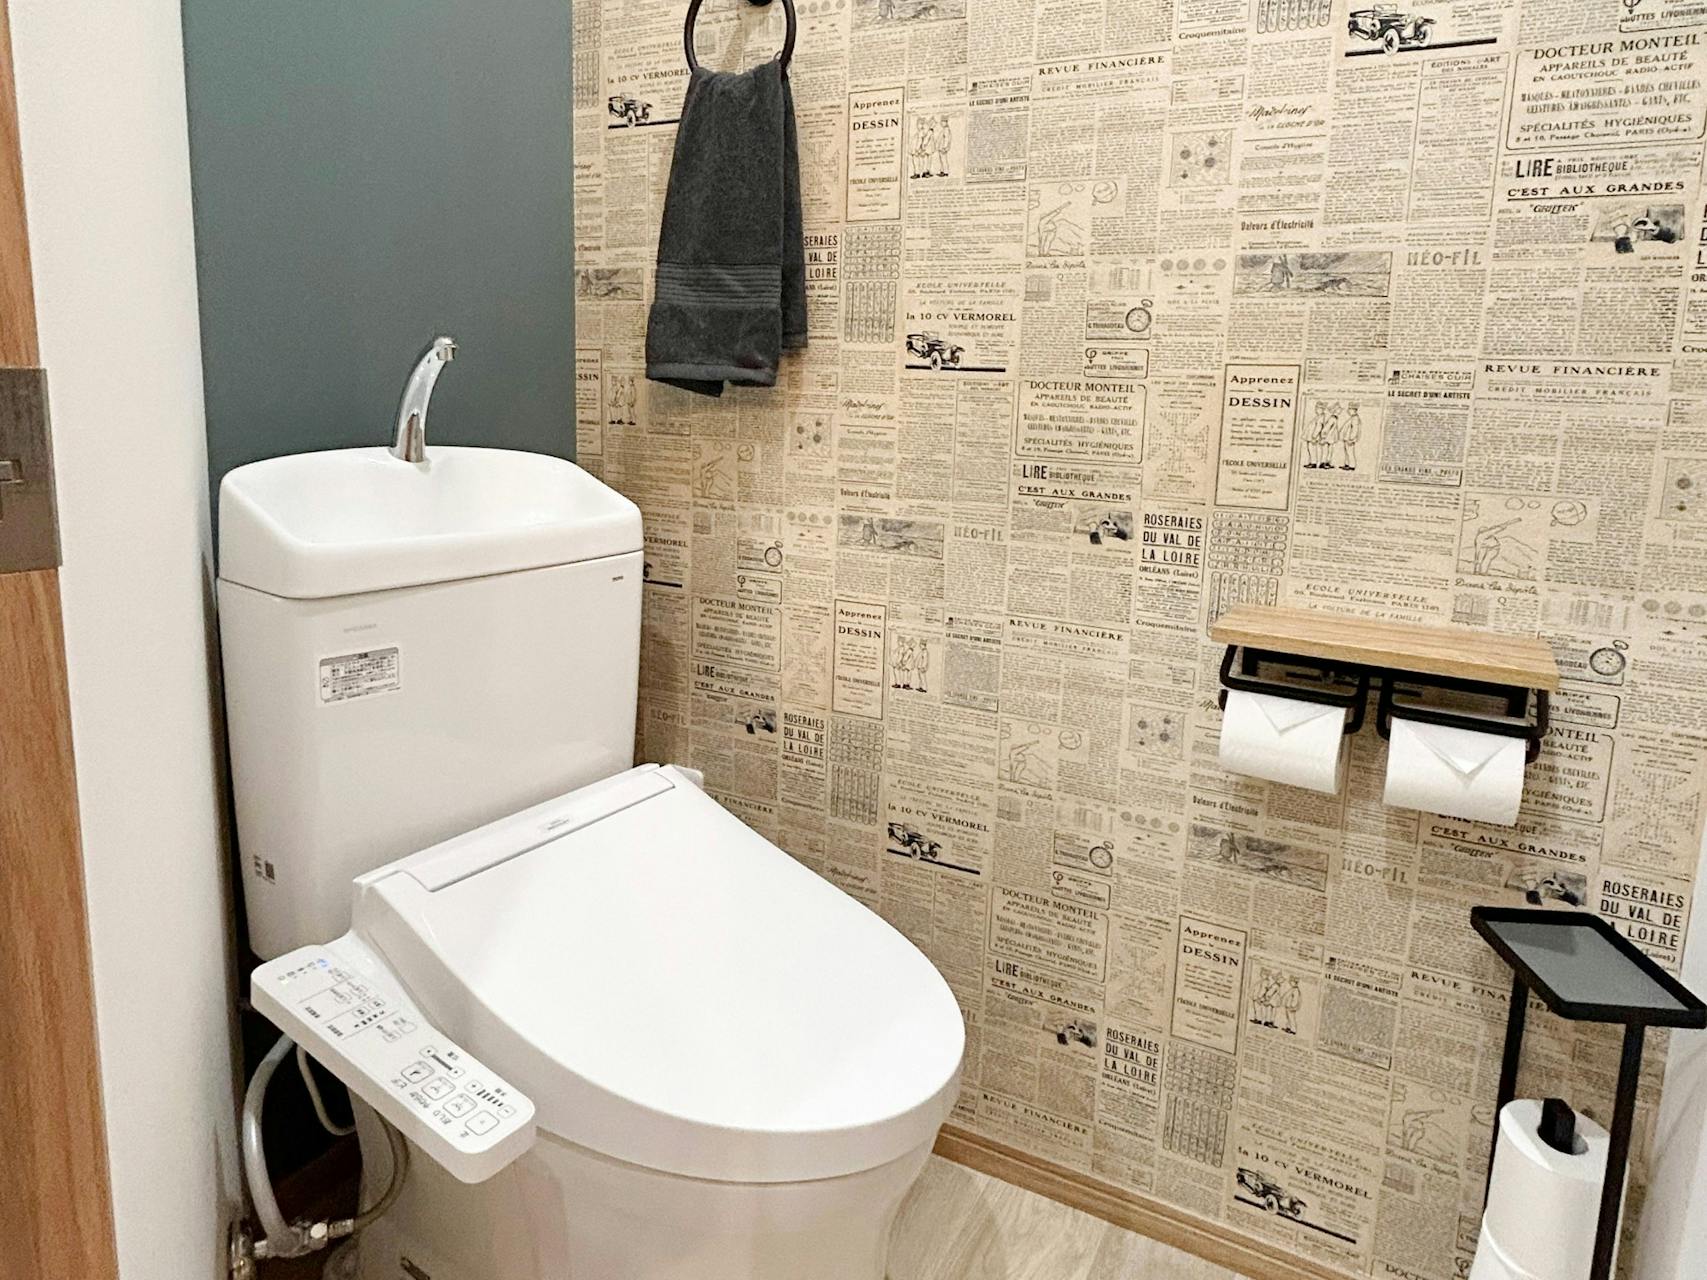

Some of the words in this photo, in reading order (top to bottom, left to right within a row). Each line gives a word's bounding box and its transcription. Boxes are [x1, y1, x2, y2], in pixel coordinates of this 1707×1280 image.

[1179, 27, 1247, 40] Croquemitaine
[1534, 42, 1614, 59] DOCTEUR
[1621, 34, 1700, 50] MONTEIL
[1038, 64, 1080, 76] REVUE
[1088, 55, 1165, 73] FINANCIÈRE
[1540, 59, 1605, 72] APPAREILS
[1612, 58, 1629, 67] DE
[1635, 50, 1688, 64] BEAUTÉ
[643, 69, 690, 80] VERMOREL
[853, 98, 900, 109] Apprenez
[852, 118, 899, 131] DESSIN
[1520, 119, 1595, 133] SPÉCIALITÉS
[1605, 114, 1692, 128] HYGIÉNIQUES
[1516, 158, 1554, 178] LIRE
[1507, 187, 1550, 197] C'EST
[1560, 185, 1596, 195] AUX
[1606, 181, 1685, 192] GRANDES
[1241, 221, 1267, 231] Valeurs
[804, 235, 838, 246] SERAIES
[809, 252, 822, 262] VAL
[828, 251, 837, 262] DE
[809, 268, 837, 278] LOIRE
[953, 313, 1017, 321] VERMOREL
[1484, 364, 1542, 374] REVUE
[1553, 364, 1661, 377] FINANCIÈRE
[1030, 381, 1081, 391] DOCTEUR
[1085, 383, 1136, 393] MONTEIL
[1230, 375, 1294, 386] Apprenez
[1096, 395, 1129, 403] BEAUTÉ
[1229, 396, 1292, 408] DESSIN
[1024, 438, 1072, 447] SPÉCIALITÉS
[1022, 464, 1047, 480] LIRE
[1018, 485, 1046, 494] C'EST
[1052, 487, 1075, 497] AUX
[1081, 490, 1132, 500] GRANDES
[1144, 513, 1202, 529] ROSERAIES
[1143, 531, 1156, 543] DU
[1164, 533, 1182, 545] VAL
[1188, 535, 1201, 547] DE
[1142, 548, 1155, 560] LA
[1164, 550, 1199, 565] LOIRE
[1139, 566, 1170, 575] ORLÉANS
[1306, 583, 1340, 593] ECOLE
[1348, 589, 1427, 602] UNIVERSELLE
[700, 598, 736, 610] DOCTEUR
[739, 601, 774, 615] MONTEIL
[838, 608, 882, 620] Apprenez
[838, 625, 882, 639] DESSIN
[1009, 619, 1048, 631] REVUE
[1054, 624, 1124, 642] FINANCIÈRE
[1136, 619, 1198, 633] Croquemitaine
[696, 664, 715, 679] LIRE
[719, 684, 736, 693] AUX
[739, 691, 775, 701] GRANDES
[783, 712, 825, 730] ROSERAIES
[784, 727, 795, 738] DU
[798, 730, 810, 742] VAL
[814, 733, 824, 743] DE
[1549, 727, 1599, 743] ONTEIL
[783, 741, 794, 752] LA
[798, 743, 824, 758] LOIRE
[888, 803, 897, 811] la
[900, 807, 912, 815] 10
[931, 812, 990, 833] VERMOREL
[1431, 825, 1468, 839] C'EST
[1480, 834, 1509, 847] AUX
[1518, 842, 1587, 863] GRANDES
[1602, 880, 1685, 909] ROSERAIES
[1002, 887, 1050, 907] DOCTEUR
[1052, 901, 1099, 920] MONTEIL
[1601, 898, 1623, 915] DU
[1628, 905, 1657, 924] VAL
[1663, 912, 1682, 928] DE
[1183, 925, 1242, 946] Apprenez
[1627, 923, 1679, 947] LOIRE
[1183, 944, 1240, 967] DESSIN
[995, 959, 1019, 978] LIRE
[1412, 971, 1461, 989] REVUE
[1022, 987, 1044, 999] AUX
[1050, 994, 1096, 1014] GRANDES
[1106, 1027, 1160, 1054] ROSERAIES
[1105, 1043, 1118, 1055] DU
[1123, 1049, 1141, 1062] VAL
[1145, 1056, 1158, 1068] DE
[1104, 1058, 1118, 1071] LA
[1123, 1063, 1157, 1084] LOIRE
[982, 1092, 1017, 1111] REVUE
[1023, 1105, 1088, 1135] FINANCIÈRE
[1255, 1151, 1270, 1163] 10
[1294, 1162, 1372, 1200] VERMOREL
